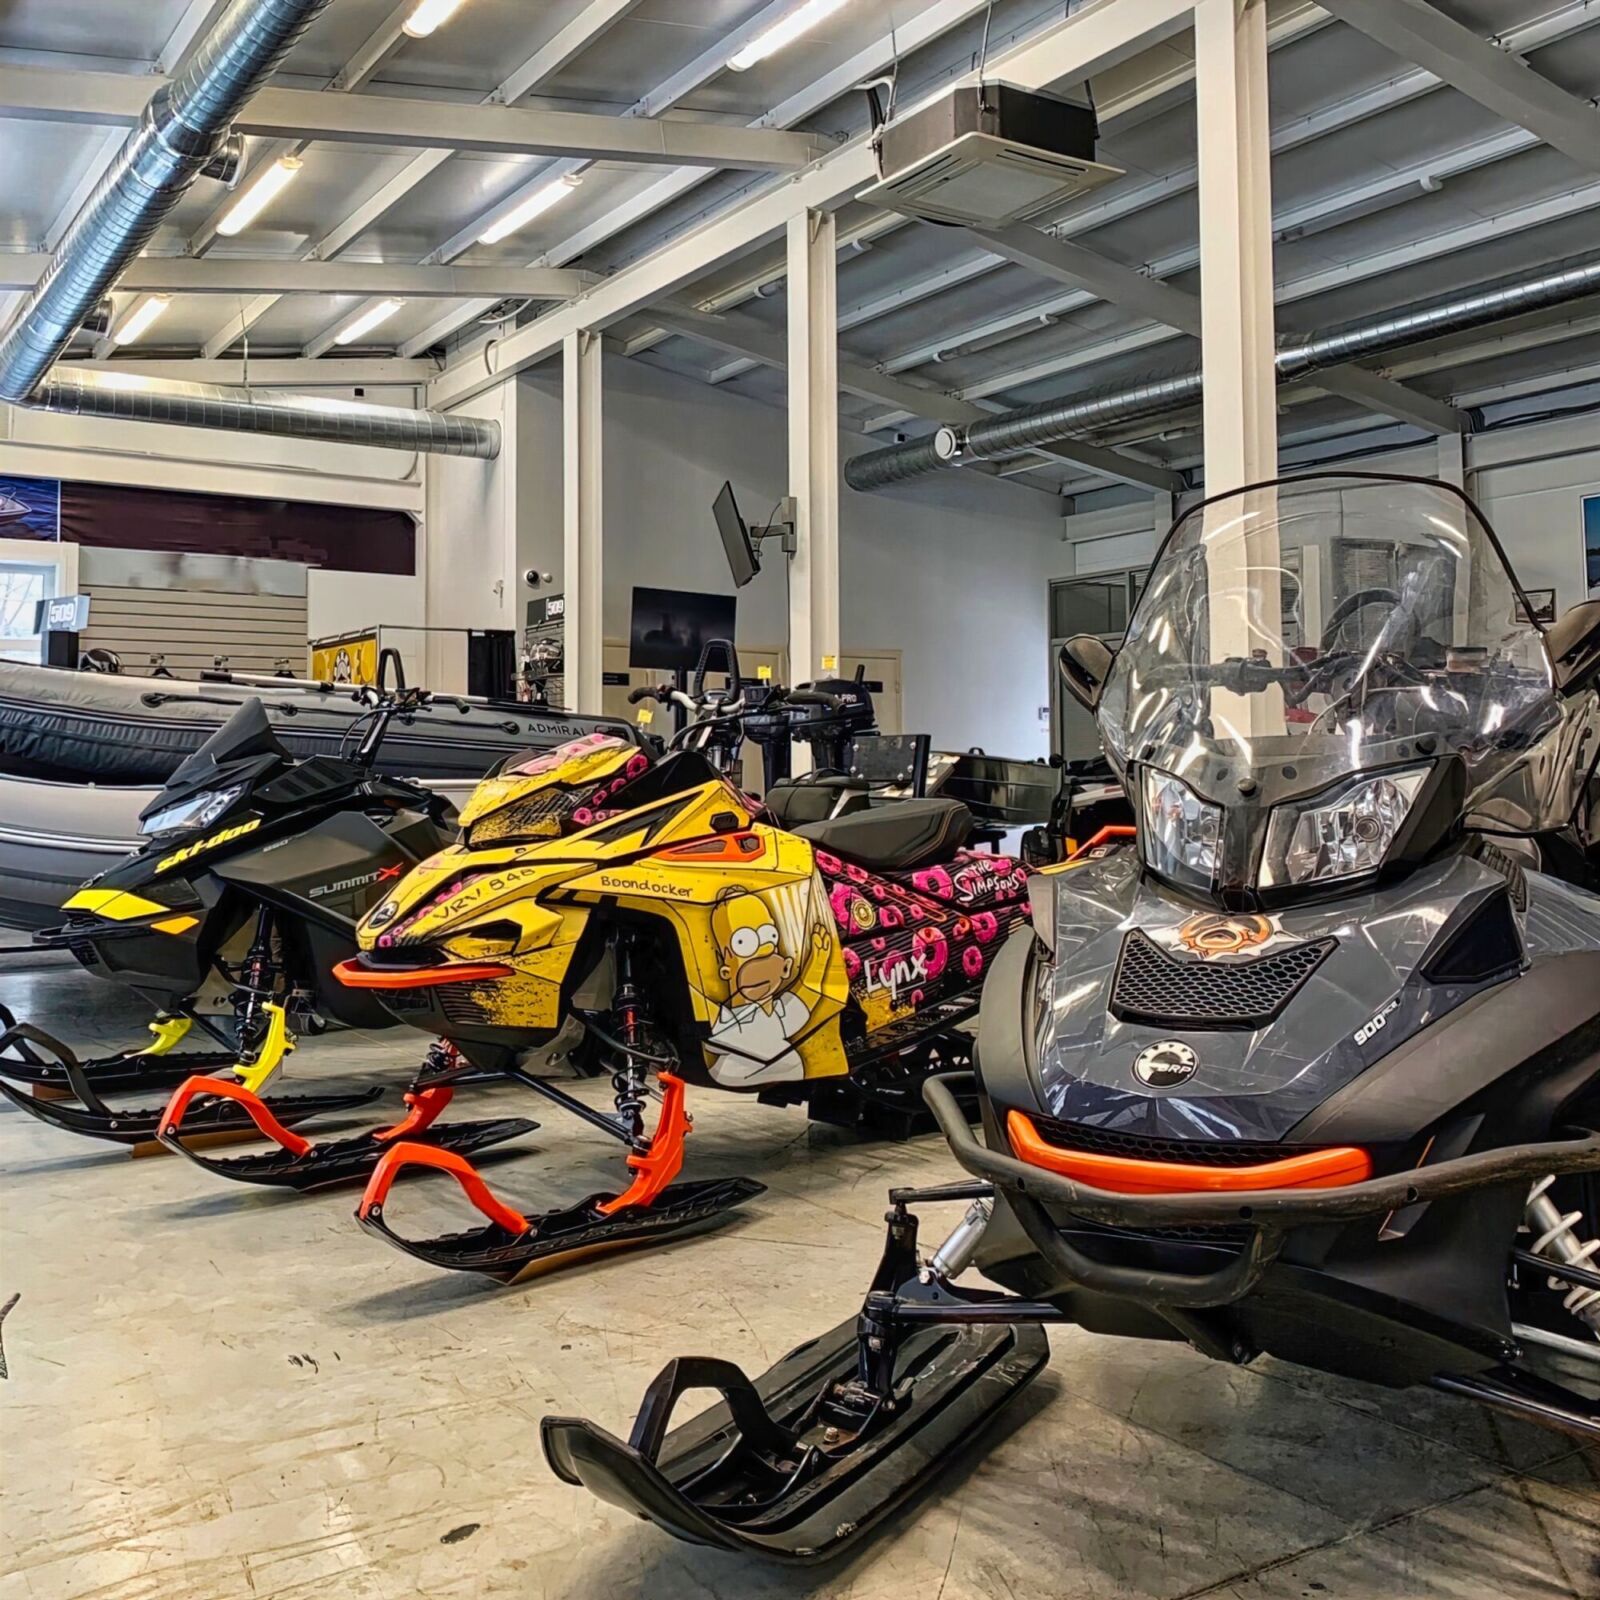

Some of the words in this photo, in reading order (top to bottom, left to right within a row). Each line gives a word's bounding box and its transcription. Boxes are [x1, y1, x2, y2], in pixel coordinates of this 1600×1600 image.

[528, 721, 587, 737] ADMIRAL
[600, 875, 694, 898] Boondocker
[863, 953, 929, 1001] Lynx
[1353, 1013, 1387, 1046] 900
